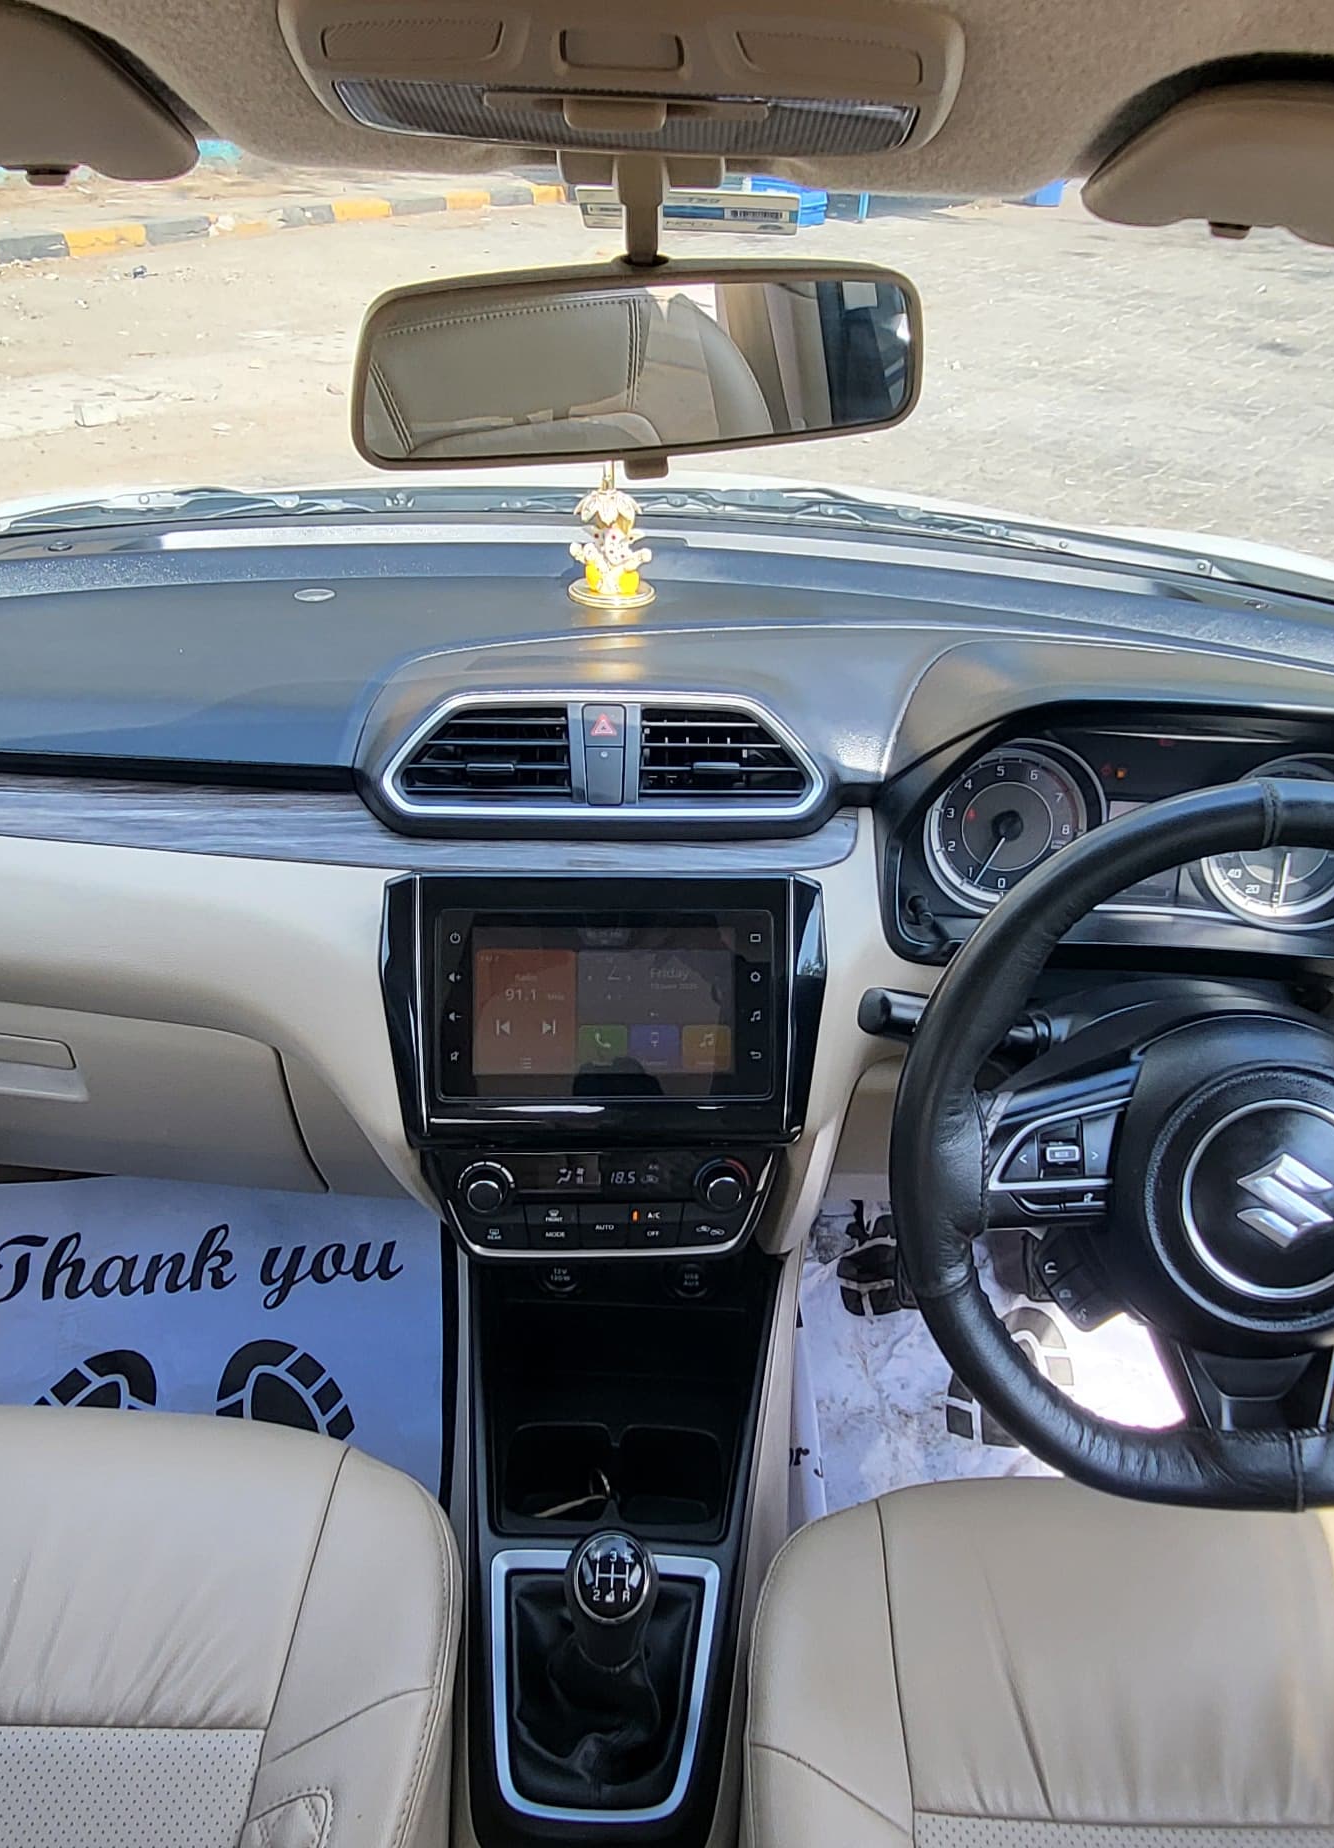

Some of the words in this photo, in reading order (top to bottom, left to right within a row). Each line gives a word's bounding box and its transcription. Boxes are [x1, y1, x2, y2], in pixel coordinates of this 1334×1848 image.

[996, 766, 1005, 776] 5
[1030, 770, 1038, 780] 6
[964, 779, 972, 789] 4
[1055, 793, 1063, 802] 7
[947, 808, 955, 818] 3
[1061, 825, 1070, 835] 8
[948, 841, 956, 851] 2
[968, 867, 973, 877] 1
[1227, 869, 1242, 878] 40
[997, 878, 1006, 888] 0
[1245, 885, 1260, 894] 20
[650, 968, 691, 982] Friday
[505, 988, 538, 1001] 91.1
[611, 1171, 636, 1185] 18.5
[260, 1239, 404, 1310] you
[610, 1551, 617, 1562] 3
[593, 1589, 600, 1601] 2
[622, 1590, 630, 1602] R
